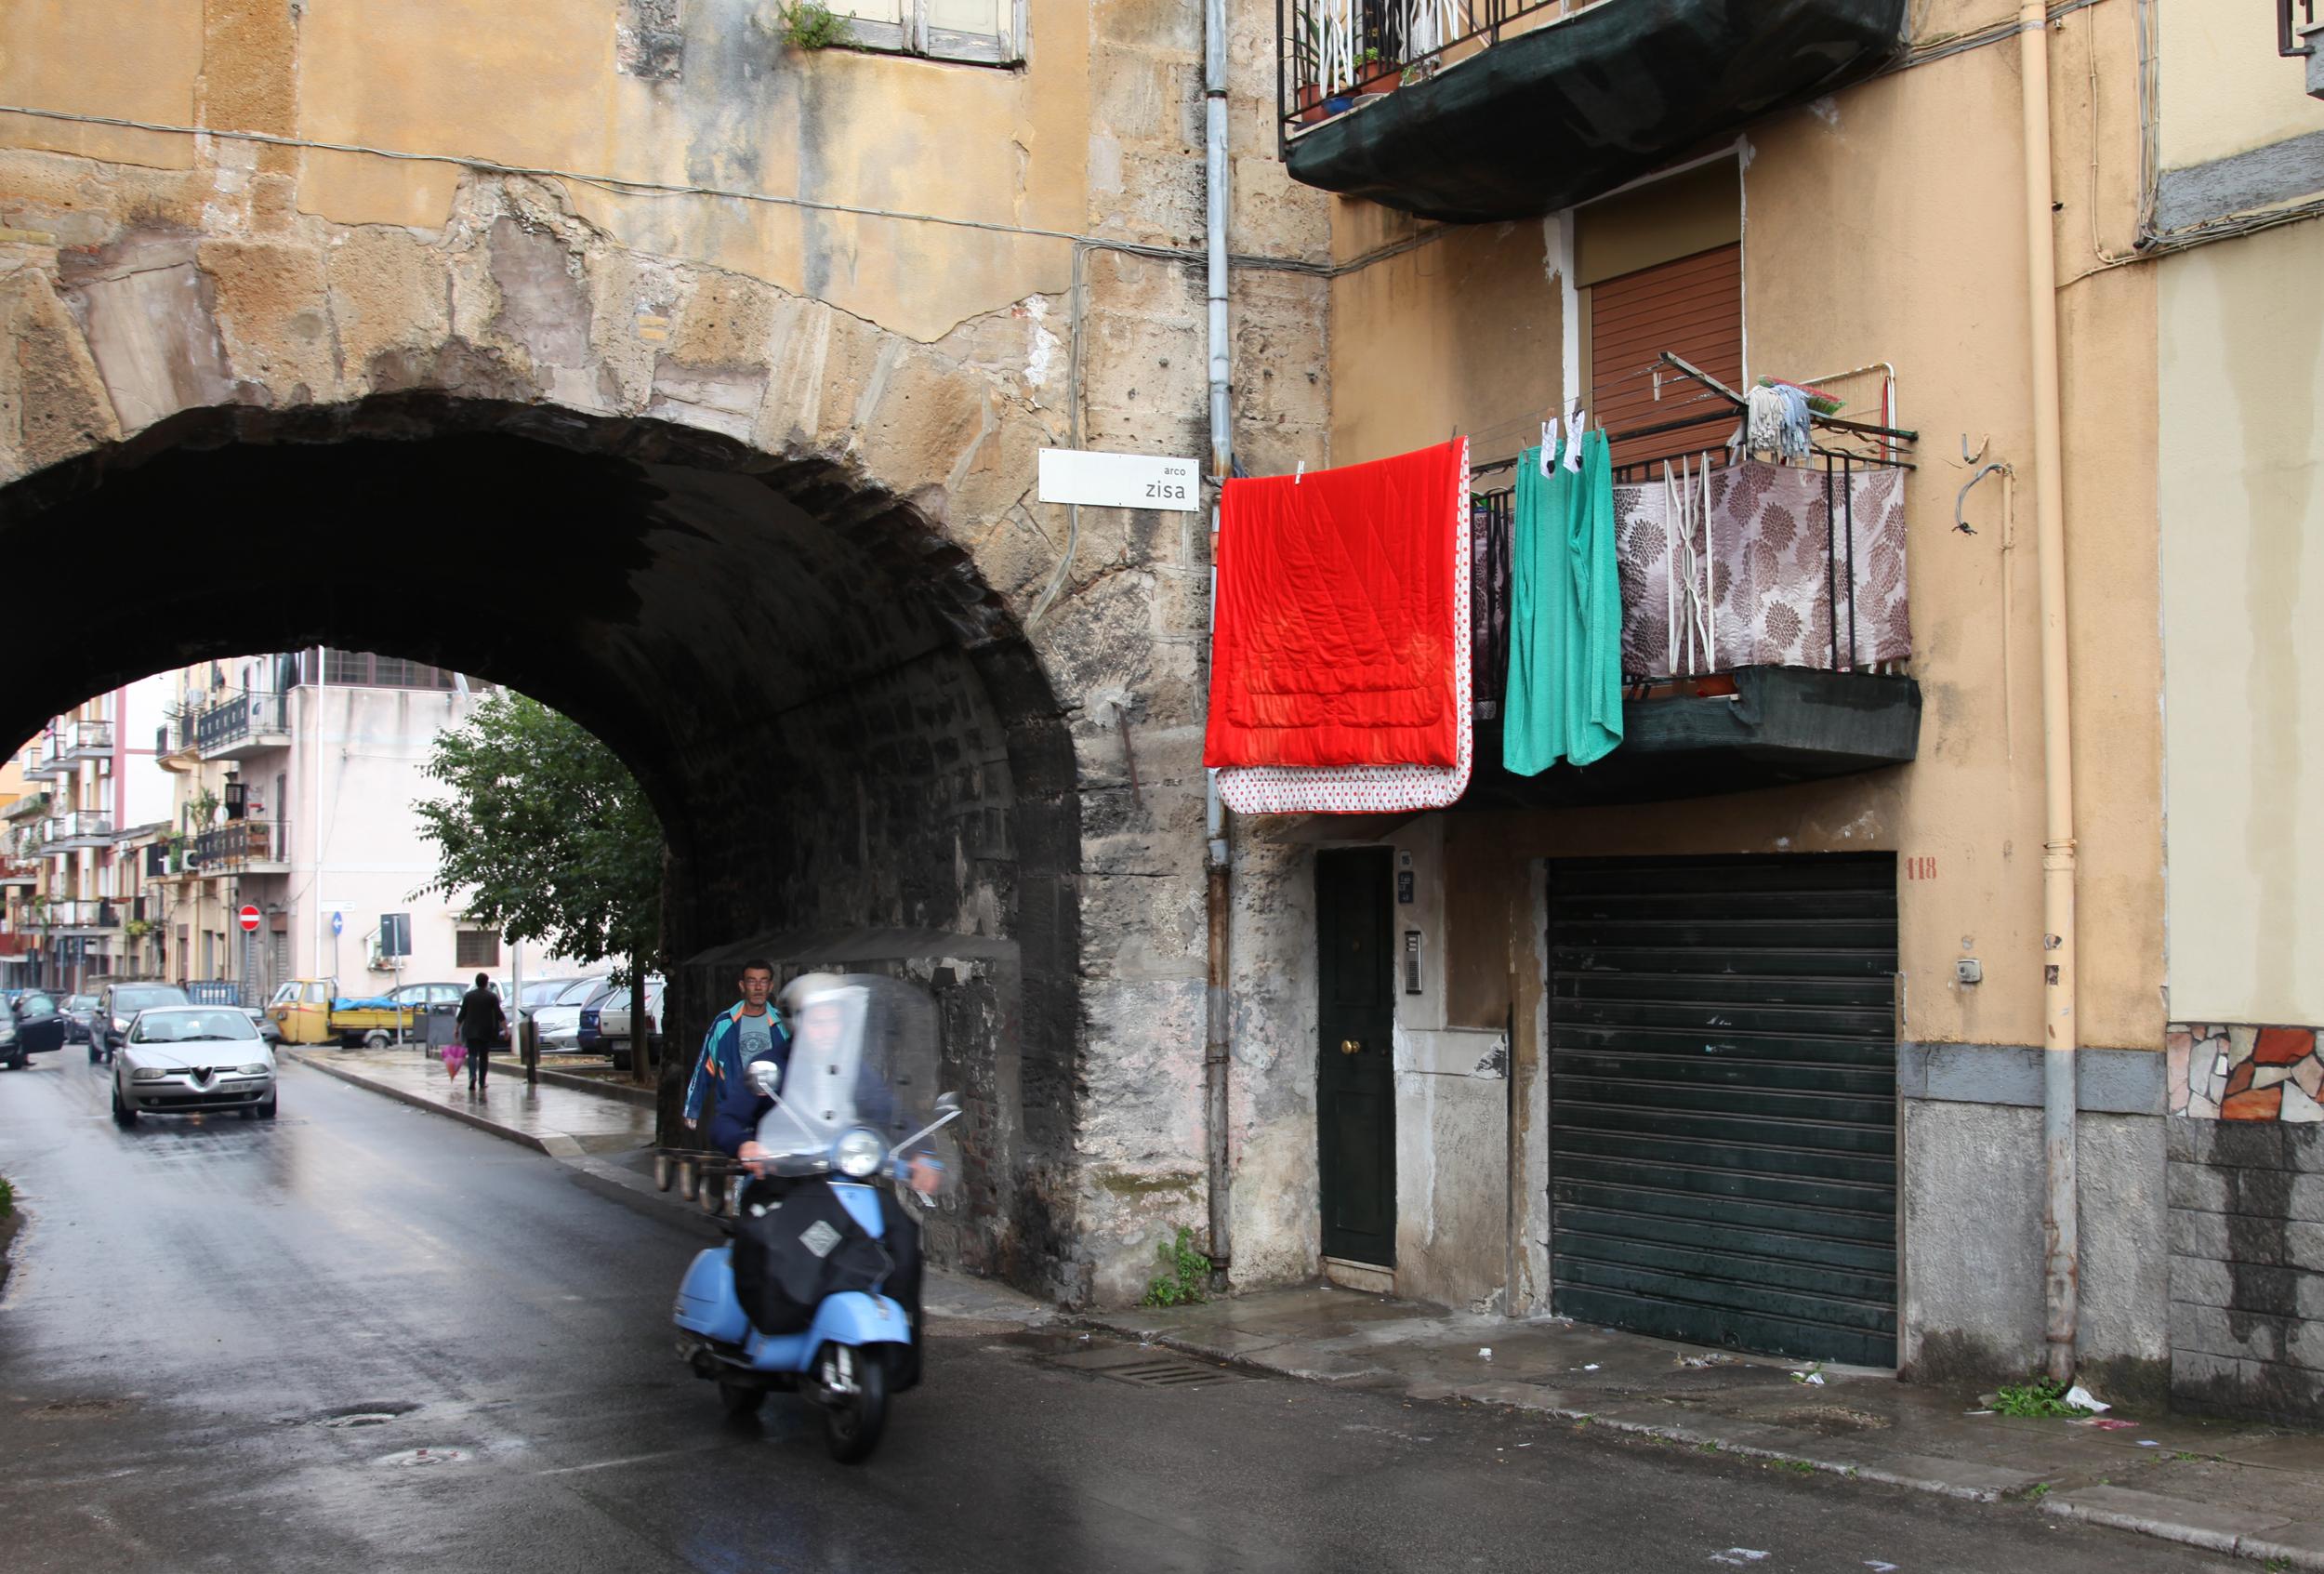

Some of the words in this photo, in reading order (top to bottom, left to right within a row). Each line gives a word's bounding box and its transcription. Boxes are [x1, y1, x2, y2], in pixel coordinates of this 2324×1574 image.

[1164, 467, 1186, 476] arco
[1145, 480, 1185, 499] zisa
[1907, 856, 1936, 880] 118
